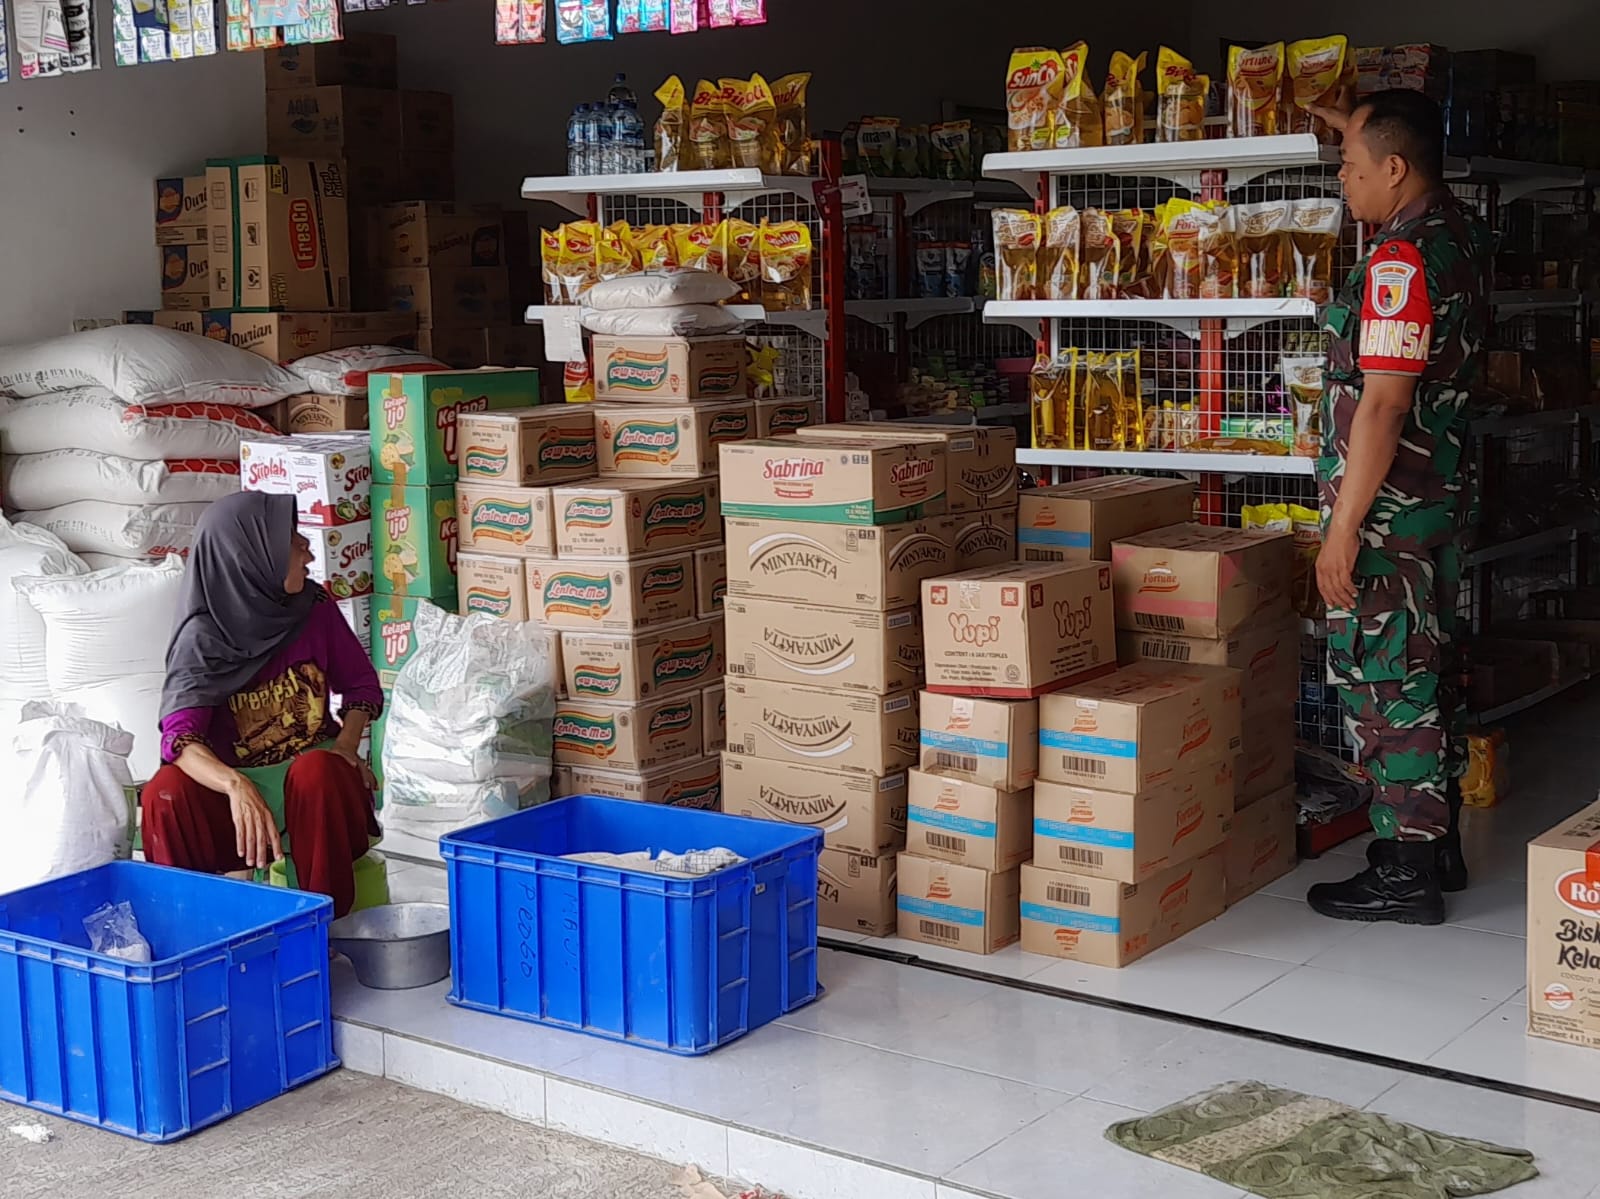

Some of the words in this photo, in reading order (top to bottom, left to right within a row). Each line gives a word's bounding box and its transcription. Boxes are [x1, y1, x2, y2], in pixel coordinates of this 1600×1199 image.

[1010, 65, 1057, 88] SunCo
[185, 190, 207, 211] Duri
[292, 202, 313, 261] FresCo
[190, 260, 209, 278] Dur
[232, 322, 272, 347] Durian
[249, 459, 287, 485] Siiplah
[343, 464, 371, 493] Siip
[763, 457, 824, 480] Sabrina
[890, 458, 934, 484] Sabrina
[389, 517, 408, 541] Ijo
[339, 532, 371, 569] Siipl
[760, 551, 838, 580] MINYAKITA
[382, 620, 411, 638] Kelapa
[948, 612, 1001, 647] Yupi
[1054, 596, 1092, 639] Yupi
[385, 633, 408, 665] Ijo
[763, 626, 843, 656] MINYAKITA
[762, 707, 841, 737] MINYAKITA
[759, 784, 836, 816] MINYAKITA
[1556, 919, 1600, 942] Bisk
[1557, 943, 1600, 971] Kela
